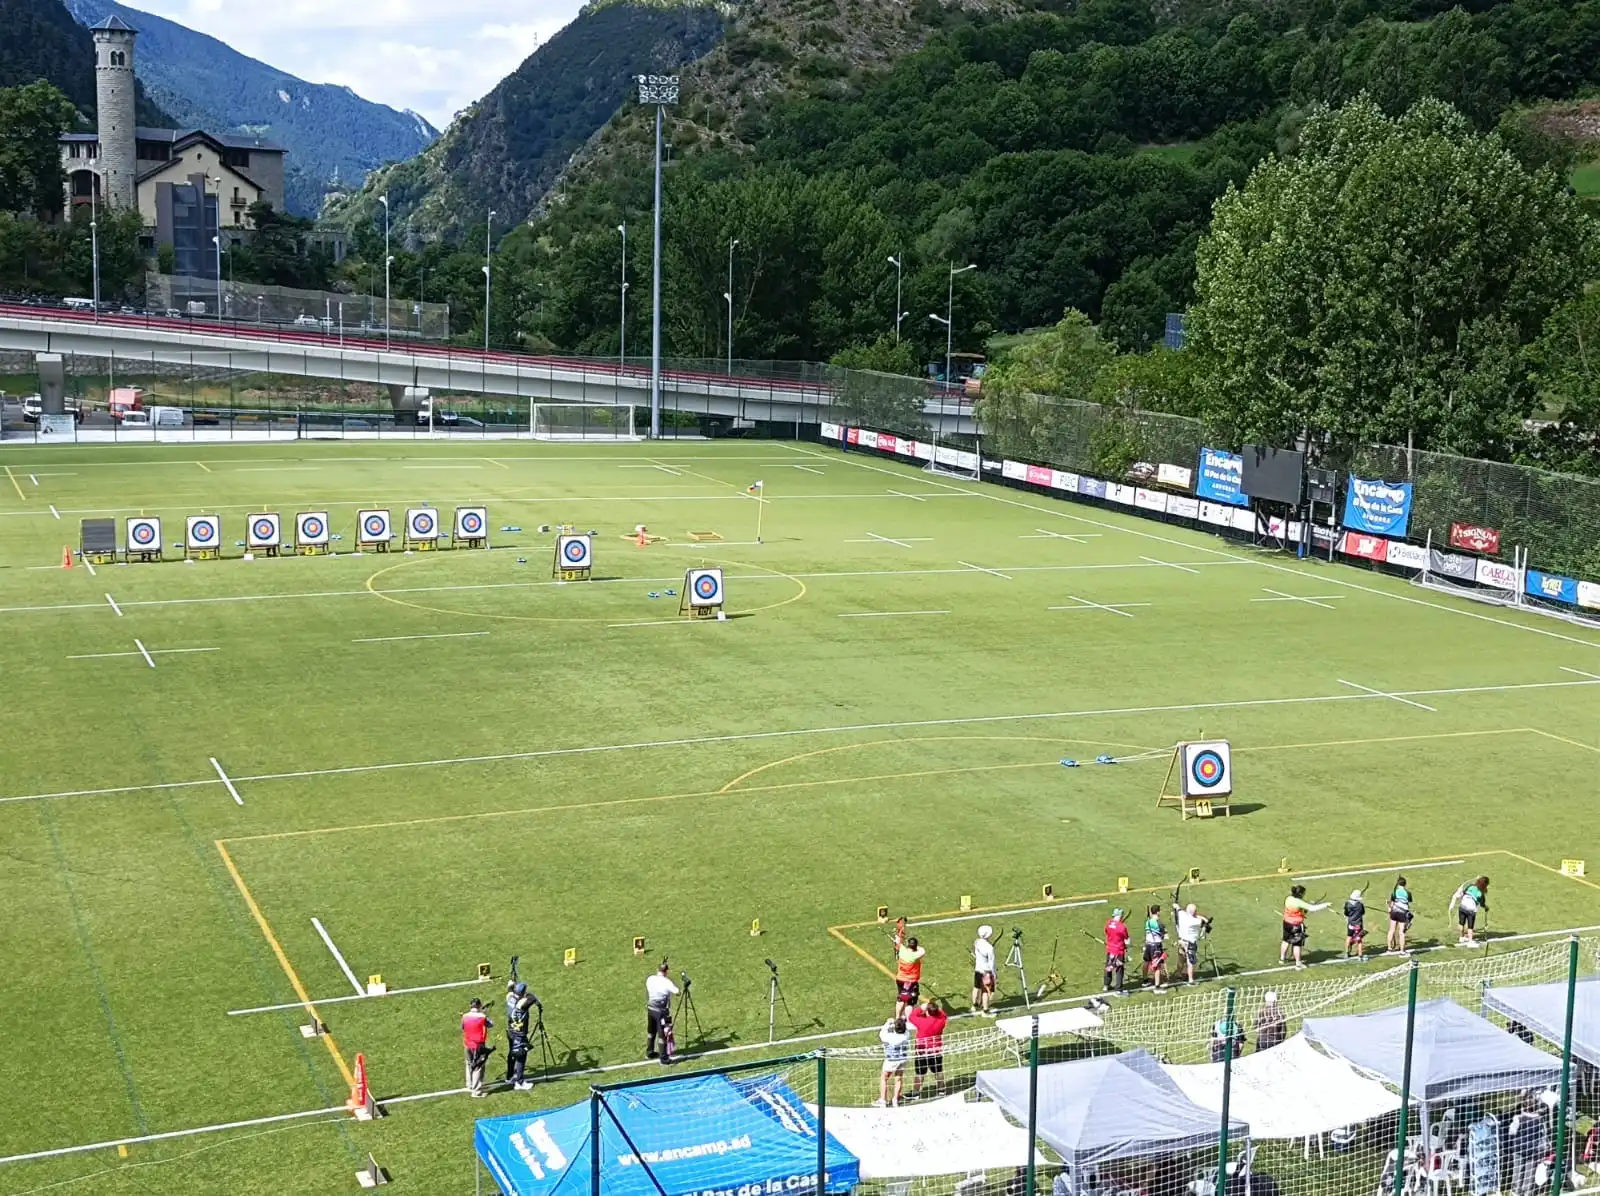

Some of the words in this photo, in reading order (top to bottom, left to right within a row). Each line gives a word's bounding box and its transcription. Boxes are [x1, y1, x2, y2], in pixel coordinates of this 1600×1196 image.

[1205, 452, 1243, 474] Encam
[1354, 479, 1405, 504] Encamp
[1197, 802, 1210, 814] 11
[617, 1134, 752, 1166] www.encamp.ad
